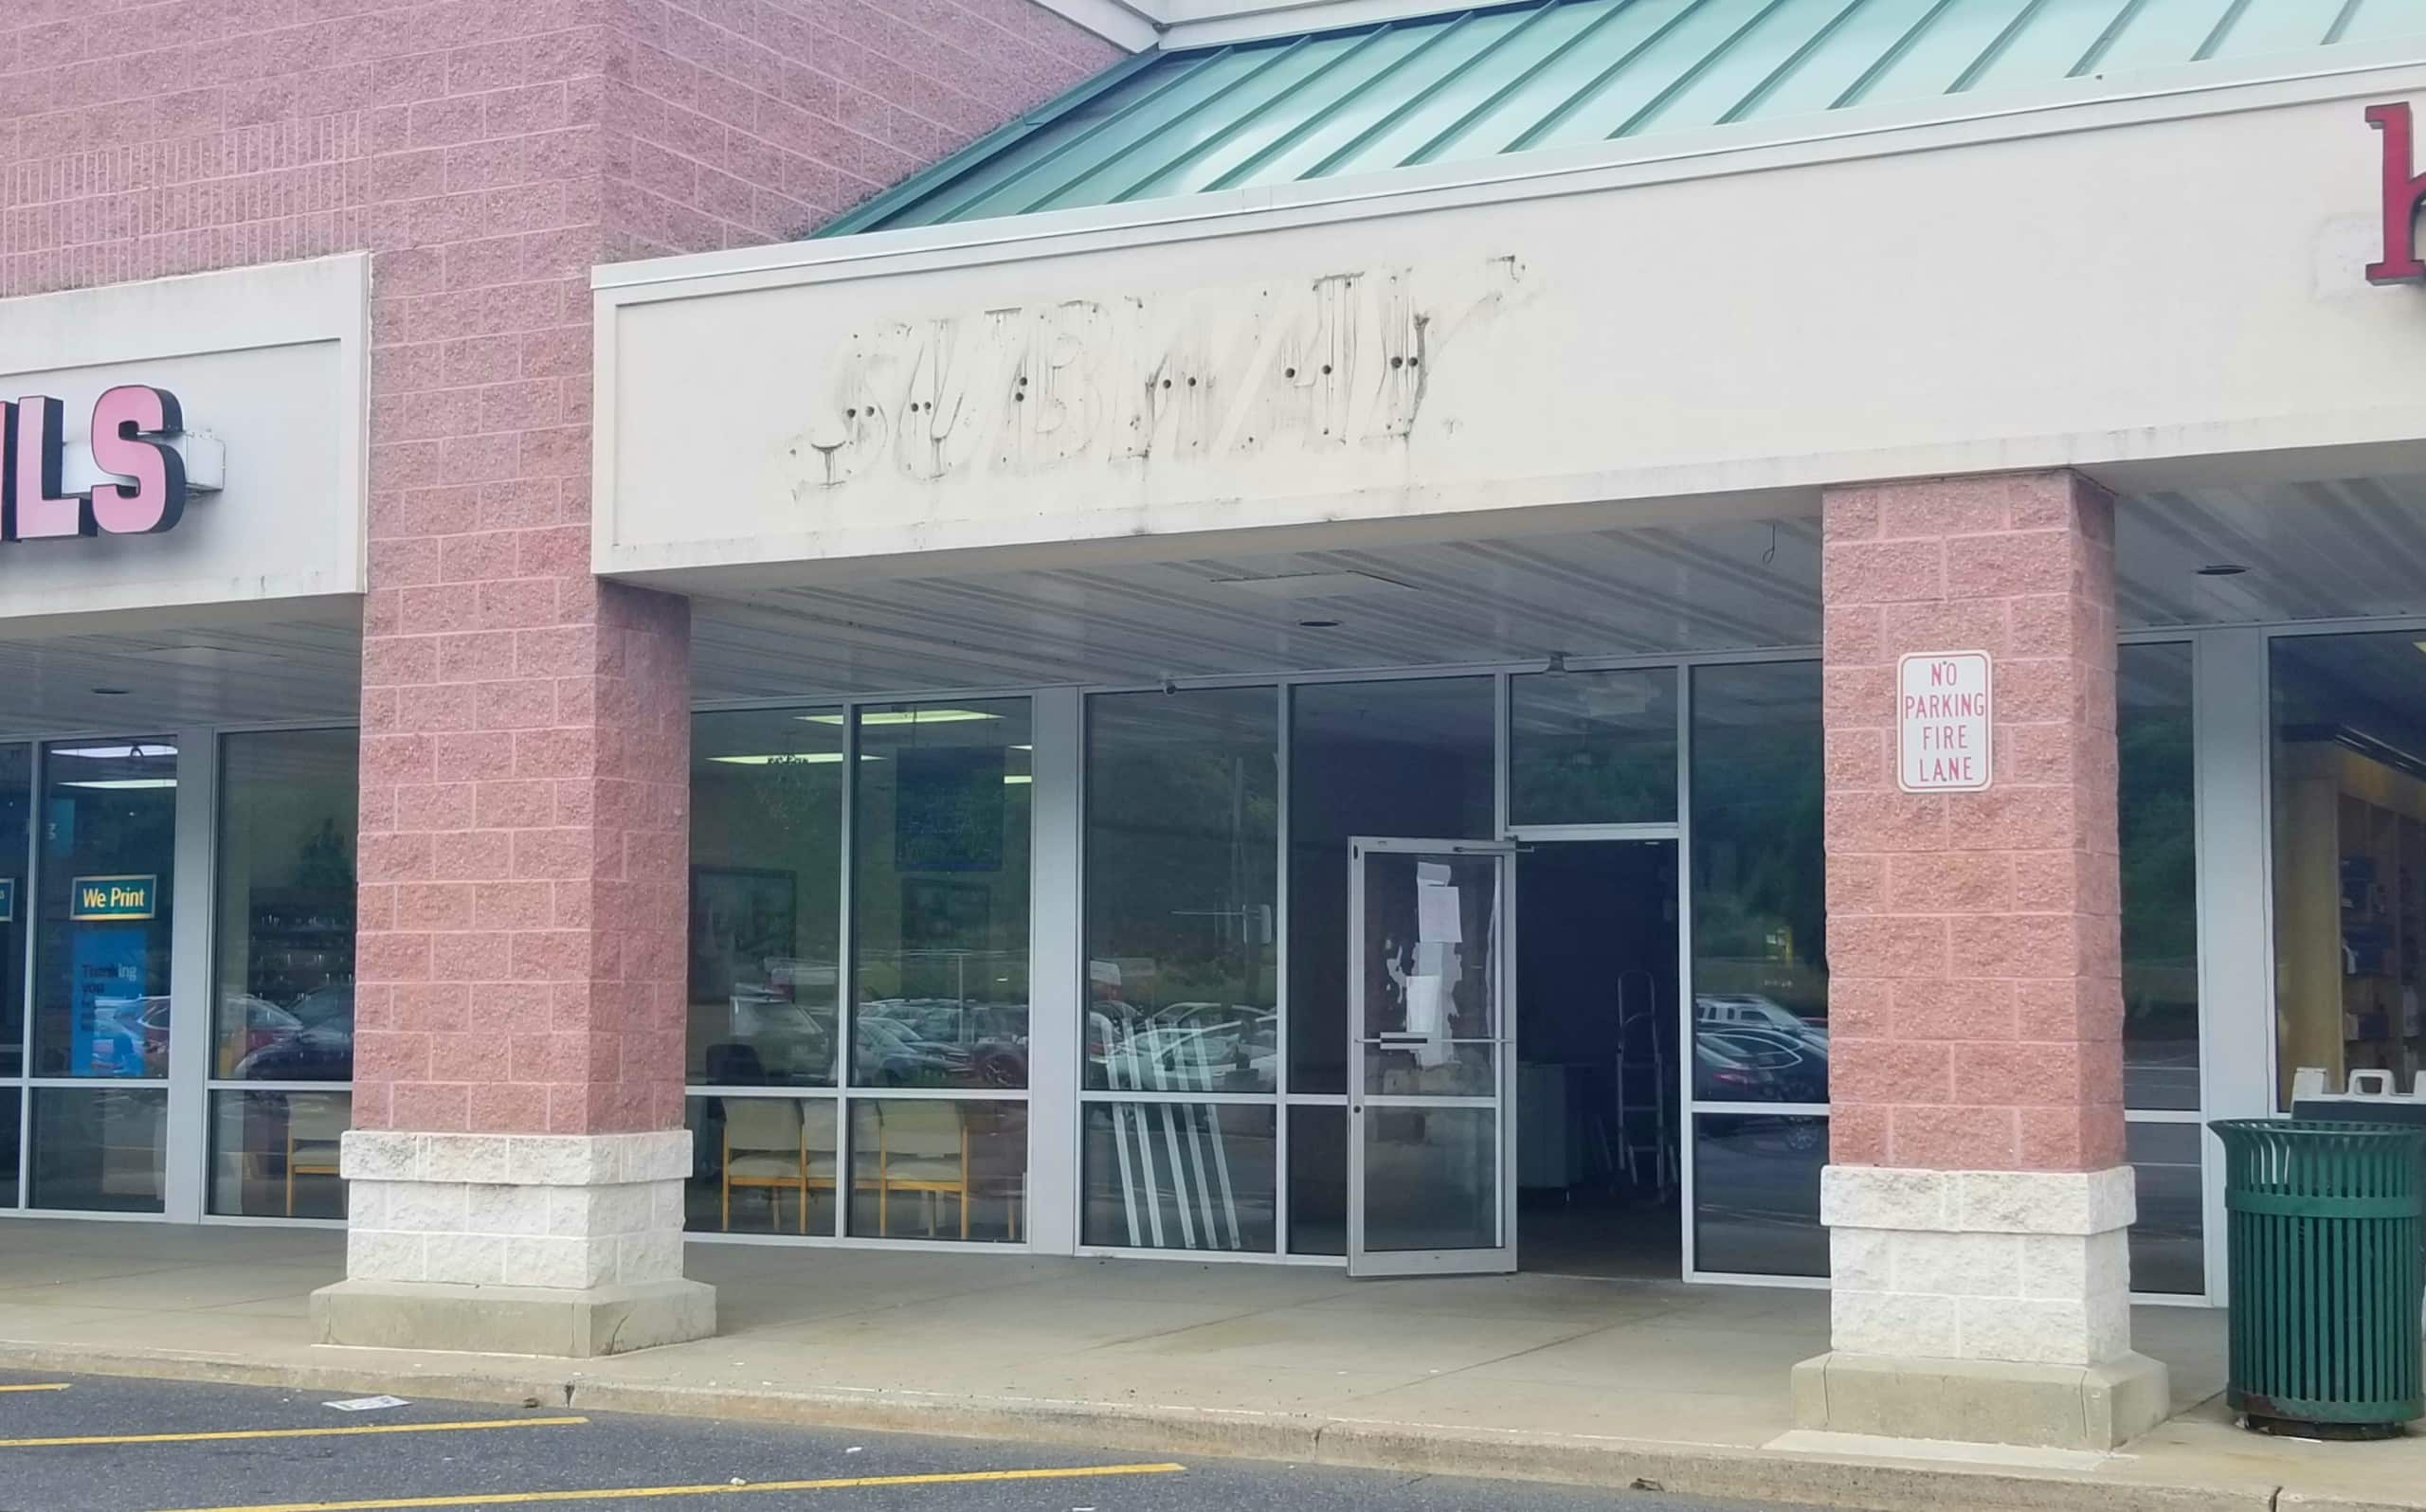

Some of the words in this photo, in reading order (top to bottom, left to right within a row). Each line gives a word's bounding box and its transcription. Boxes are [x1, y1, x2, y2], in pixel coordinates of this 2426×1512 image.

[0, 385, 186, 542] LS
[1930, 662, 1958, 687] NO
[1905, 693, 1985, 720] PARKING
[1923, 725, 1968, 751] FIRE
[1919, 756, 1974, 783] LANE
[82, 887, 106, 909] We
[110, 886, 146, 909] Print
